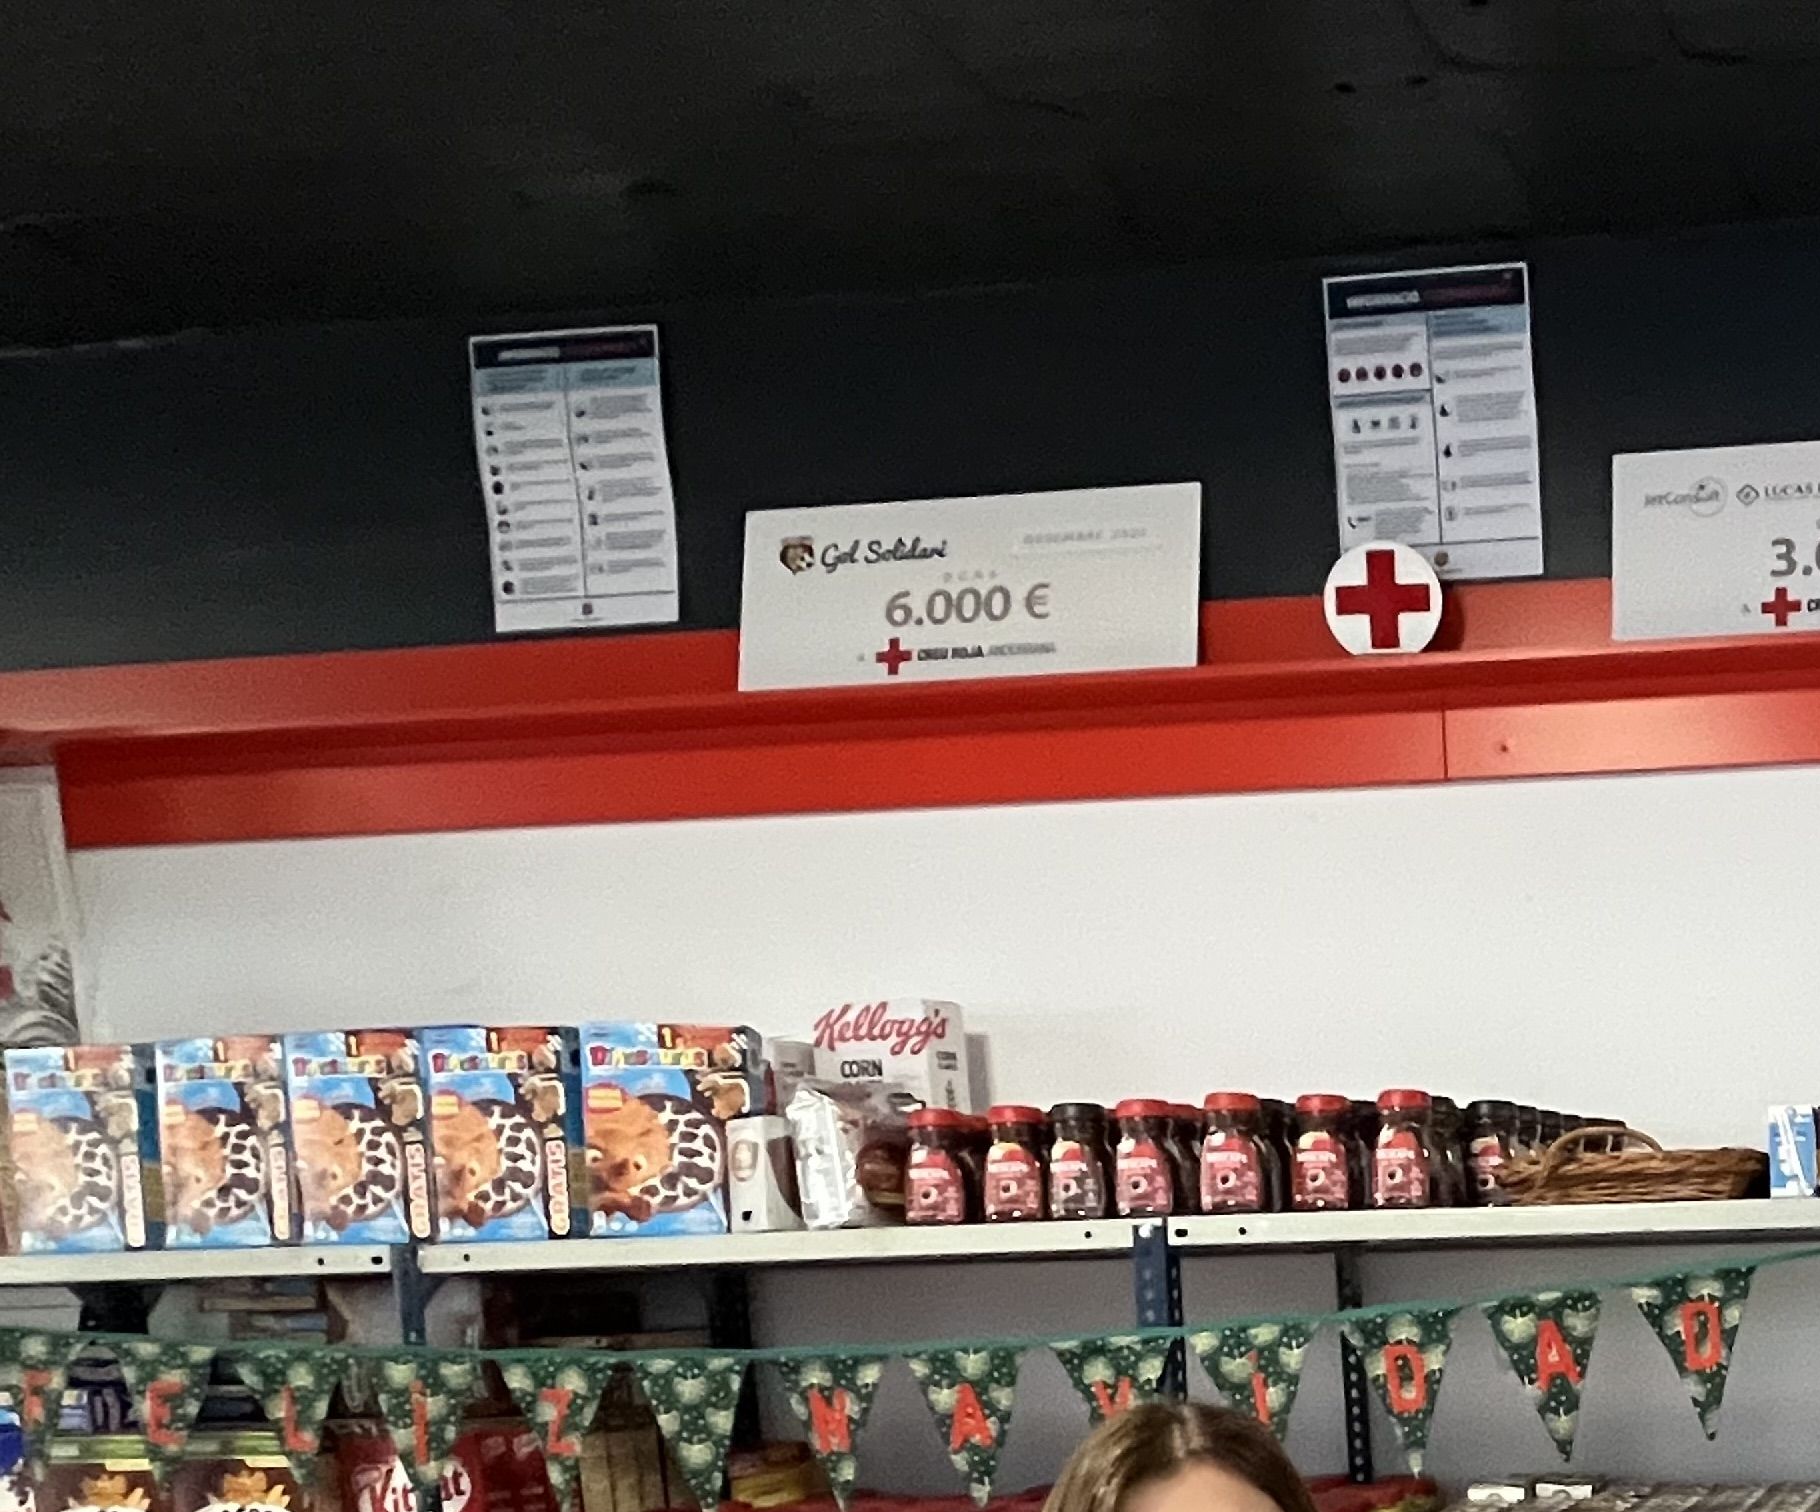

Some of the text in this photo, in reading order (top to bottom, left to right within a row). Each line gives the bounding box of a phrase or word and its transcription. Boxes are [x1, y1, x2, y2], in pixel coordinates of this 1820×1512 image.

[885, 582, 1052, 627] 6.000 €
[813, 1001, 948, 1055] Kellogg's
[840, 1058, 884, 1078] CORN
